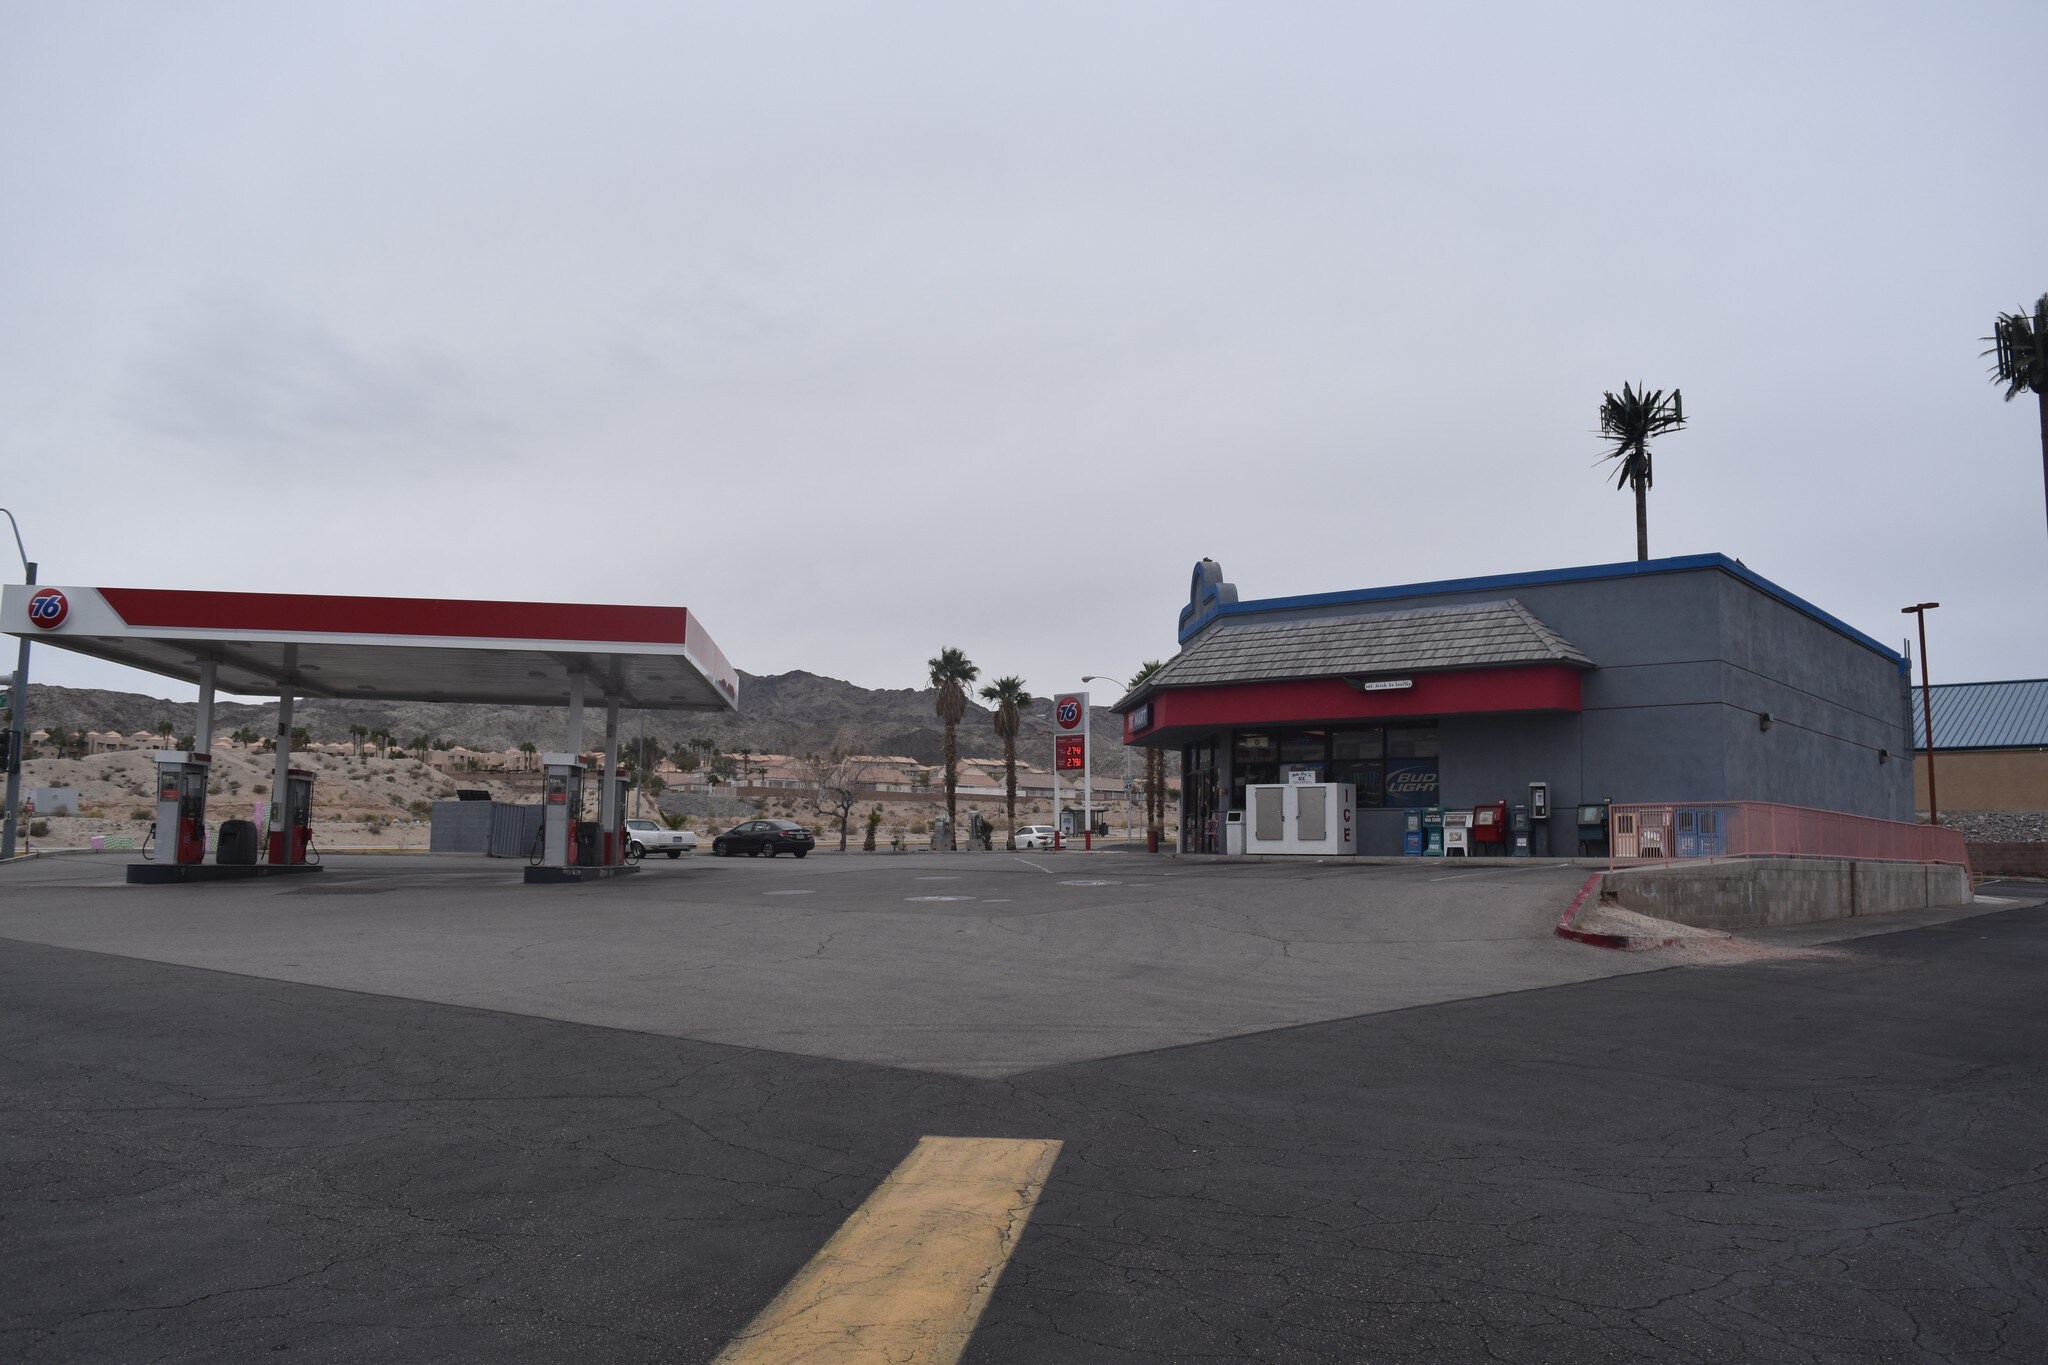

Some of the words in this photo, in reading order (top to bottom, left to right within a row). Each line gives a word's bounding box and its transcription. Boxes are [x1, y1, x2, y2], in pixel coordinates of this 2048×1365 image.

[31, 595, 62, 619] 76
[1060, 702, 1077, 721] 76
[1388, 782, 1440, 792] LIGHT
[1397, 773, 1437, 783] BUD
[1343, 789, 1351, 842] ICE
